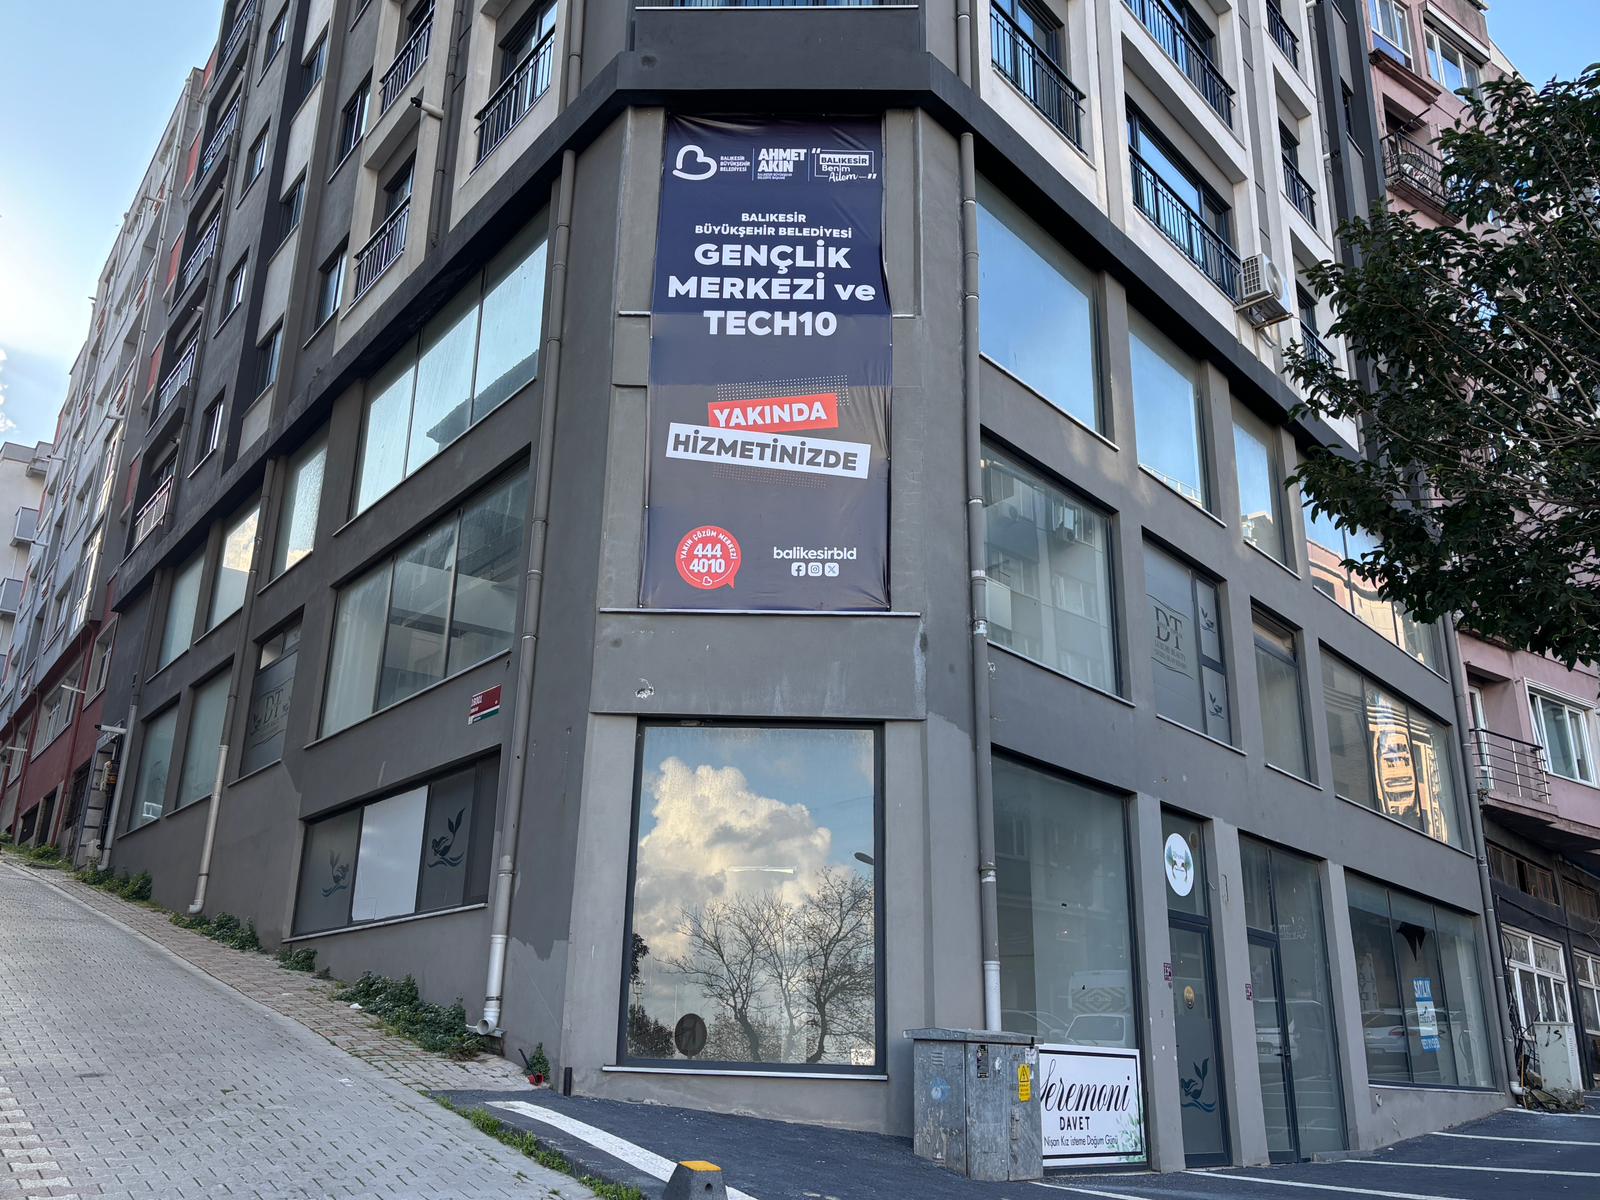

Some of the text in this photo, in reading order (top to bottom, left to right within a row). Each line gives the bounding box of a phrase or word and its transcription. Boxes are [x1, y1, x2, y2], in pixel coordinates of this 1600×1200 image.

[758, 148, 807, 161] AHMET
[821, 155, 868, 165] BALIKESİR
[757, 161, 793, 172] AKIN
[822, 165, 851, 173] Benim
[829, 171, 858, 182] Ailem
[741, 212, 806, 223] BALIKESİR
[695, 223, 852, 238] BÜYÜKŞEHİR BELEDİYESİ
[694, 240, 851, 274] GENÇLİK
[668, 272, 876, 301] MERKEZİ ve
[703, 310, 837, 337] TECH10
[713, 402, 827, 427] YAKINDA
[672, 429, 858, 471] HİZMETİNİZDE
[693, 529, 717, 542] ÇÖZÜM
[693, 543, 722, 557] 444
[773, 546, 857, 560] balikesirbld
[690, 558, 725, 573] 4010
[1059, 1116, 1090, 1131] DAVET
[1086, 1135, 1104, 1148] Doğum
[1105, 1134, 1118, 1146] Günü
